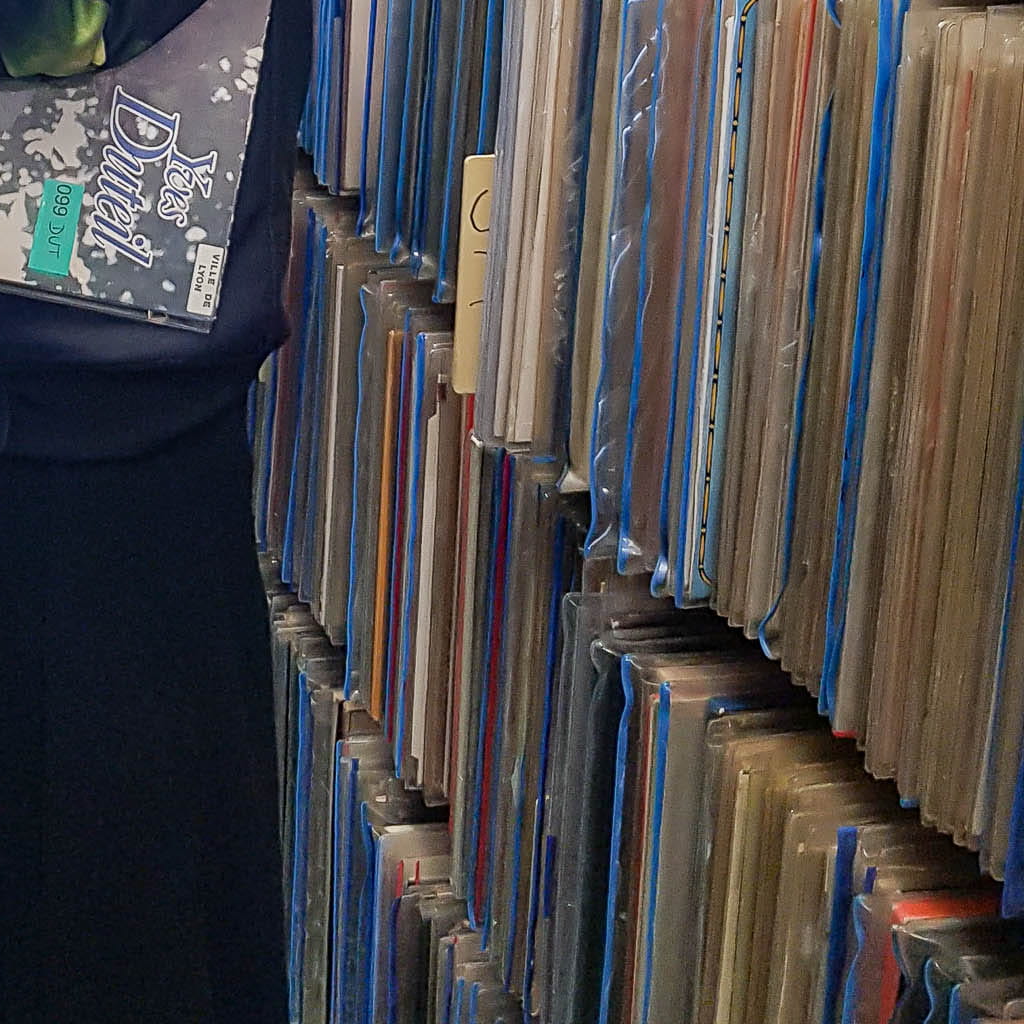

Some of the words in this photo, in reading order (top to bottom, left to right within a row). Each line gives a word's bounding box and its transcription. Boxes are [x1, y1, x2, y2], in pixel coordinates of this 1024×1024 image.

[90, 85, 181, 268] Duteil
[157, 144, 218, 228] Yves
[53, 184, 72, 217] 099
[47, 223, 65, 260] DUT
[194, 264, 207, 293] LYON
[207, 253, 221, 286] VILLE
[202, 293, 212, 309] DE
